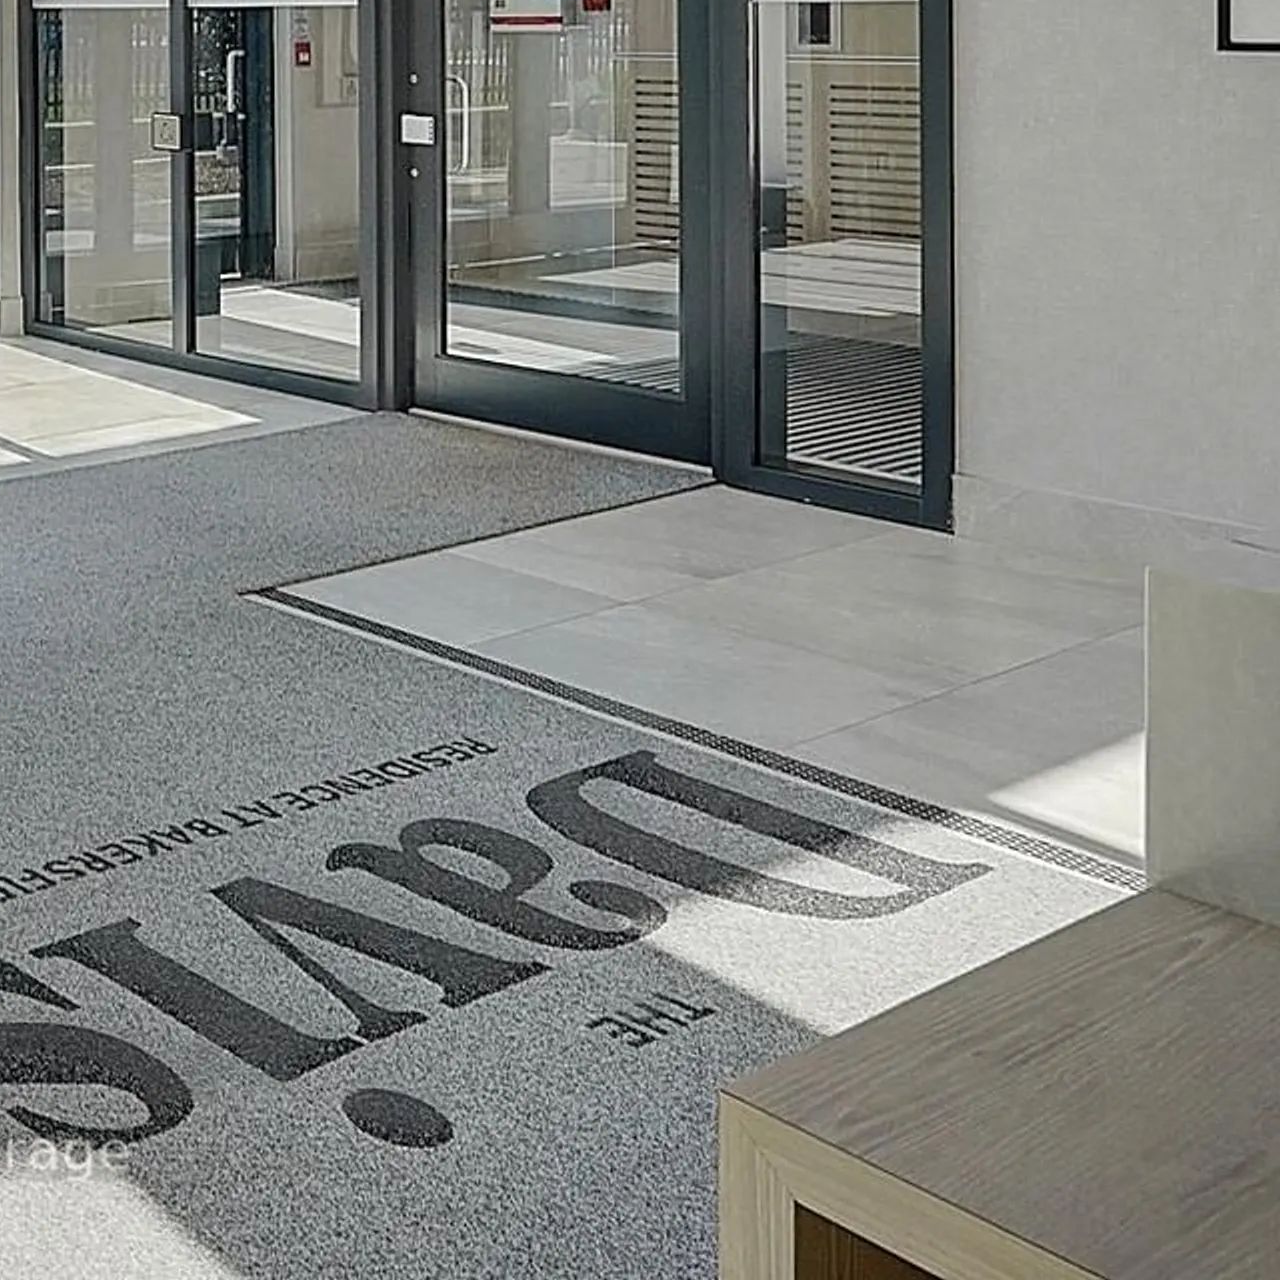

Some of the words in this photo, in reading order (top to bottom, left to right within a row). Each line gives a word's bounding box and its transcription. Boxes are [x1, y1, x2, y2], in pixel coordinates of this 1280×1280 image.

[272, 735, 498, 811] RESIDENCE
[221, 800, 282, 828] AT
[584, 990, 716, 1050] THE
